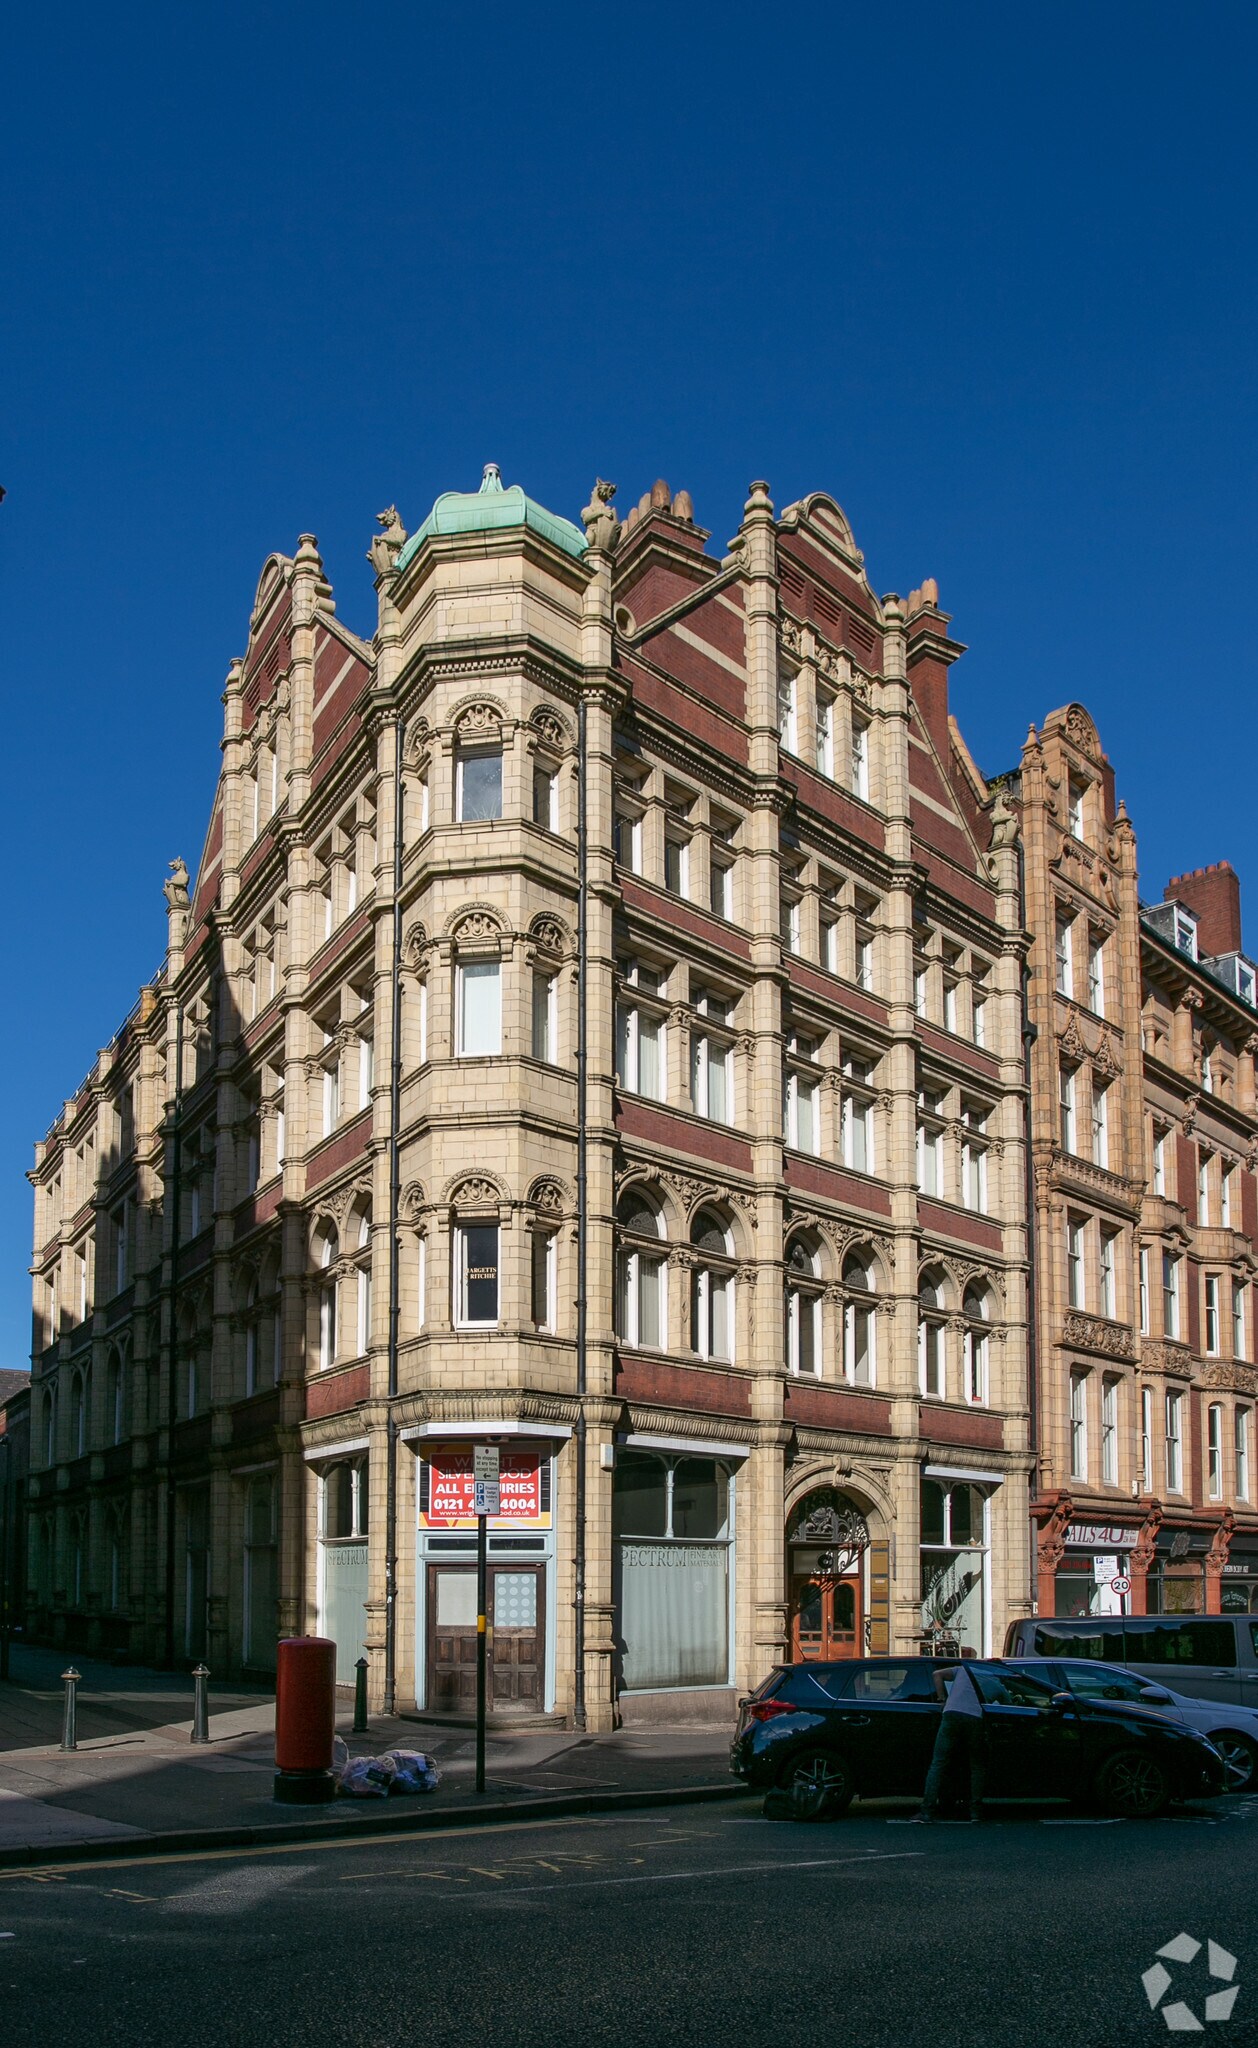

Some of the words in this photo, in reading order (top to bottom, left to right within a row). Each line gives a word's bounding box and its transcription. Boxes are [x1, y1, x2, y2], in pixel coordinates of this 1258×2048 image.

[438, 1468, 532, 1479] SILVEOOD
[435, 1483, 460, 1494] ALL
[434, 1498, 463, 1509] 0121
[500, 1498, 536, 1509] 4004
[1098, 1527, 1124, 1543] 4U
[328, 1549, 368, 1565] SPECTRUM
[622, 1549, 687, 1567] PECTRUM
[690, 1551, 707, 1559] FINE
[708, 1551, 721, 1559] ART
[1114, 1581, 1129, 1590] 20
